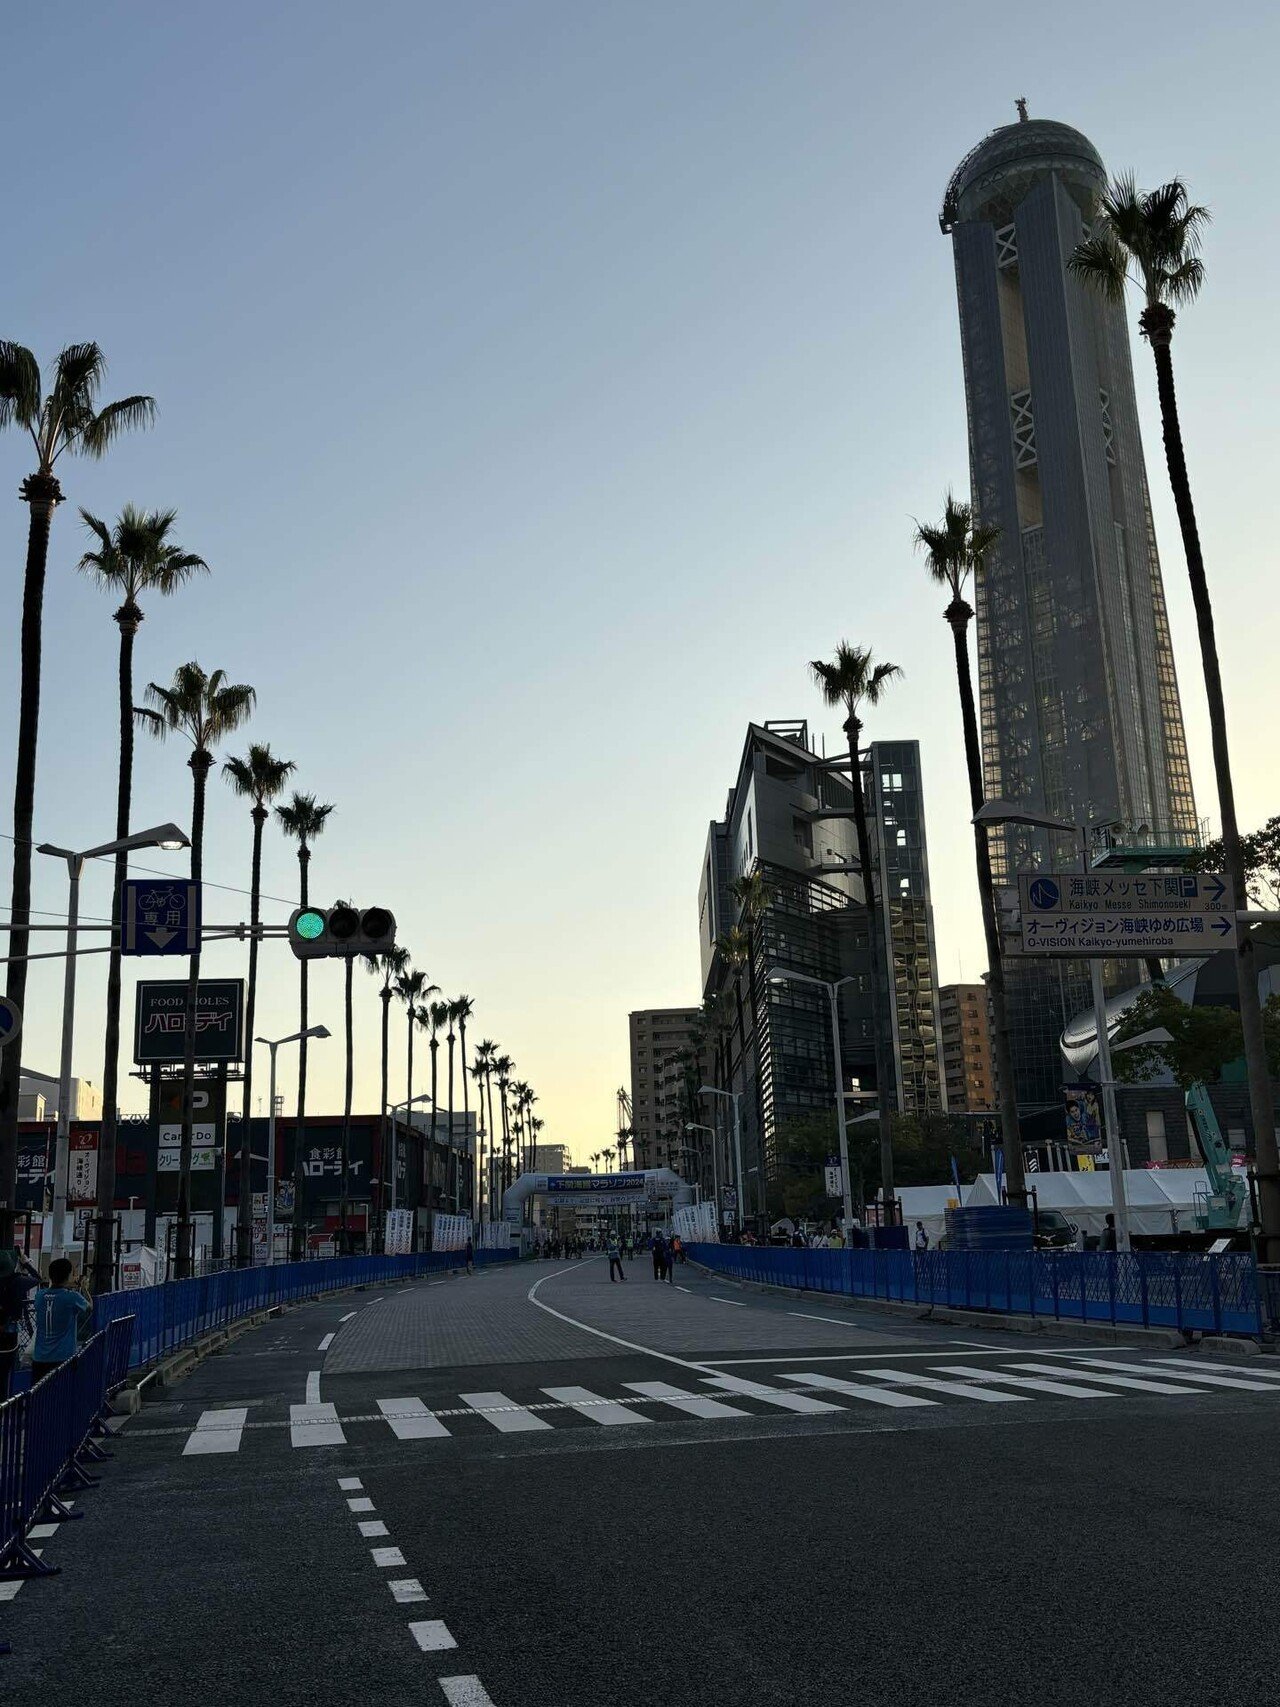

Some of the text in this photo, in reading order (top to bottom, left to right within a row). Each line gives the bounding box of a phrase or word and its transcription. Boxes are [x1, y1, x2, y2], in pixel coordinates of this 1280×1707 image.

[1070, 878, 1179, 897] 海峡メッセ下関
[1069, 899, 1099, 910] Kaikyo
[1105, 899, 1132, 909] Messe
[1138, 899, 1191, 909] Shimonoseki
[144, 911, 180, 926] 専用
[1027, 917, 1203, 934] オーヴィジョン海峡ゆめ広場
[1028, 936, 1174, 948] O-VISION Kaikyo-yumehiroba
[150, 997, 230, 1006] FOOD OLES
[145, 1012, 233, 1033] ハロデイ
[159, 1152, 200, 1167] クリーグ
